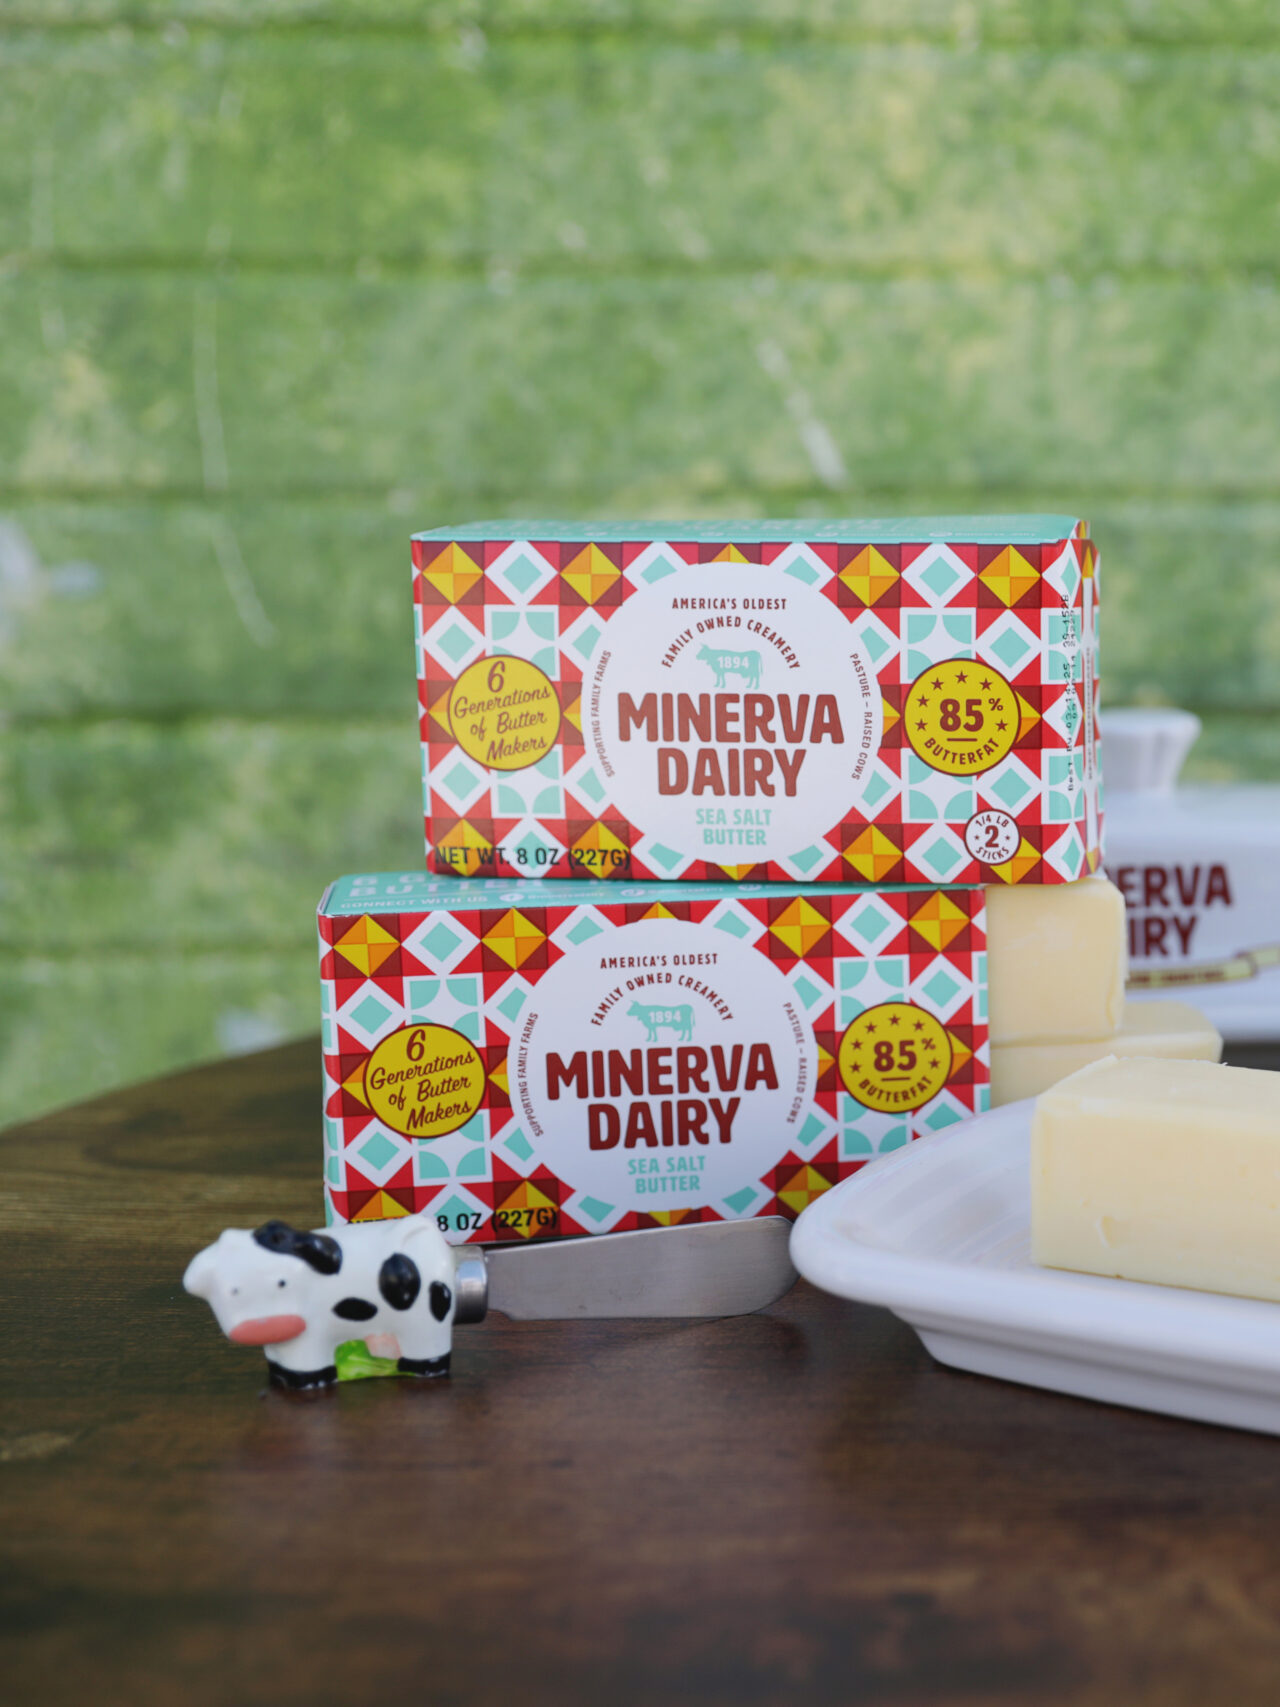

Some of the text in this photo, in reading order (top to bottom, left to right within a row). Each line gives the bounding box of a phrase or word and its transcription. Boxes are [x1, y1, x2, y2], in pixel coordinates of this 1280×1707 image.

[672, 597, 788, 610] AMERICA'S OLDEST
[661, 615, 801, 670] FAMILY OWNED CREAMERY
[487, 660, 506, 693] 6
[717, 656, 750, 669] 1894
[849, 653, 871, 698] PASTURE
[453, 686, 551, 719] Generations
[591, 650, 616, 778] SUPPORTING FAMILY FARMS
[470, 710, 548, 741] of Butter
[617, 692, 845, 744] MINERVA
[861, 711, 873, 749] RAISED
[486, 736, 548, 762] Makers
[924, 737, 999, 765] BUTTERFAT
[657, 747, 808, 797] DAIRY
[851, 752, 869, 780] COWS
[695, 808, 773, 826] SEA SALT
[975, 814, 1010, 828] 1/4 LB
[703, 828, 768, 846] BUTTER
[985, 825, 999, 848] 2
[435, 847, 631, 871] NET WT. 8 OZ (227G)
[976, 846, 1010, 861] STICKS
[1104, 863, 1233, 908] ERVA
[340, 899, 416, 909] CONNECT
[421, 896, 462, 905] WITH
[1129, 914, 1198, 957] IRY
[600, 953, 718, 969] AMERICA'S OLDEST
[591, 972, 733, 1026] FAMILY OWNED CREAMERY
[649, 1010, 682, 1023] 1894
[783, 1002, 805, 1044] PASTURE
[406, 1029, 426, 1062] 6
[370, 1051, 475, 1090] Generations
[517, 1012, 544, 1137] SUPPORTING FAMILY FARMS
[546, 1043, 779, 1101] MINERVA
[796, 1057, 807, 1093] RAISED
[388, 1076, 471, 1111] of Butter
[858, 1076, 932, 1103] BUTTERFAT
[406, 1101, 472, 1131] Makers
[588, 1097, 741, 1151] DAIRY
[787, 1095, 803, 1123] COWS
[628, 1156, 706, 1175] SEA SALT
[635, 1175, 701, 1194] BUTTER
[436, 1207, 558, 1232] 8 OZ (227G)
